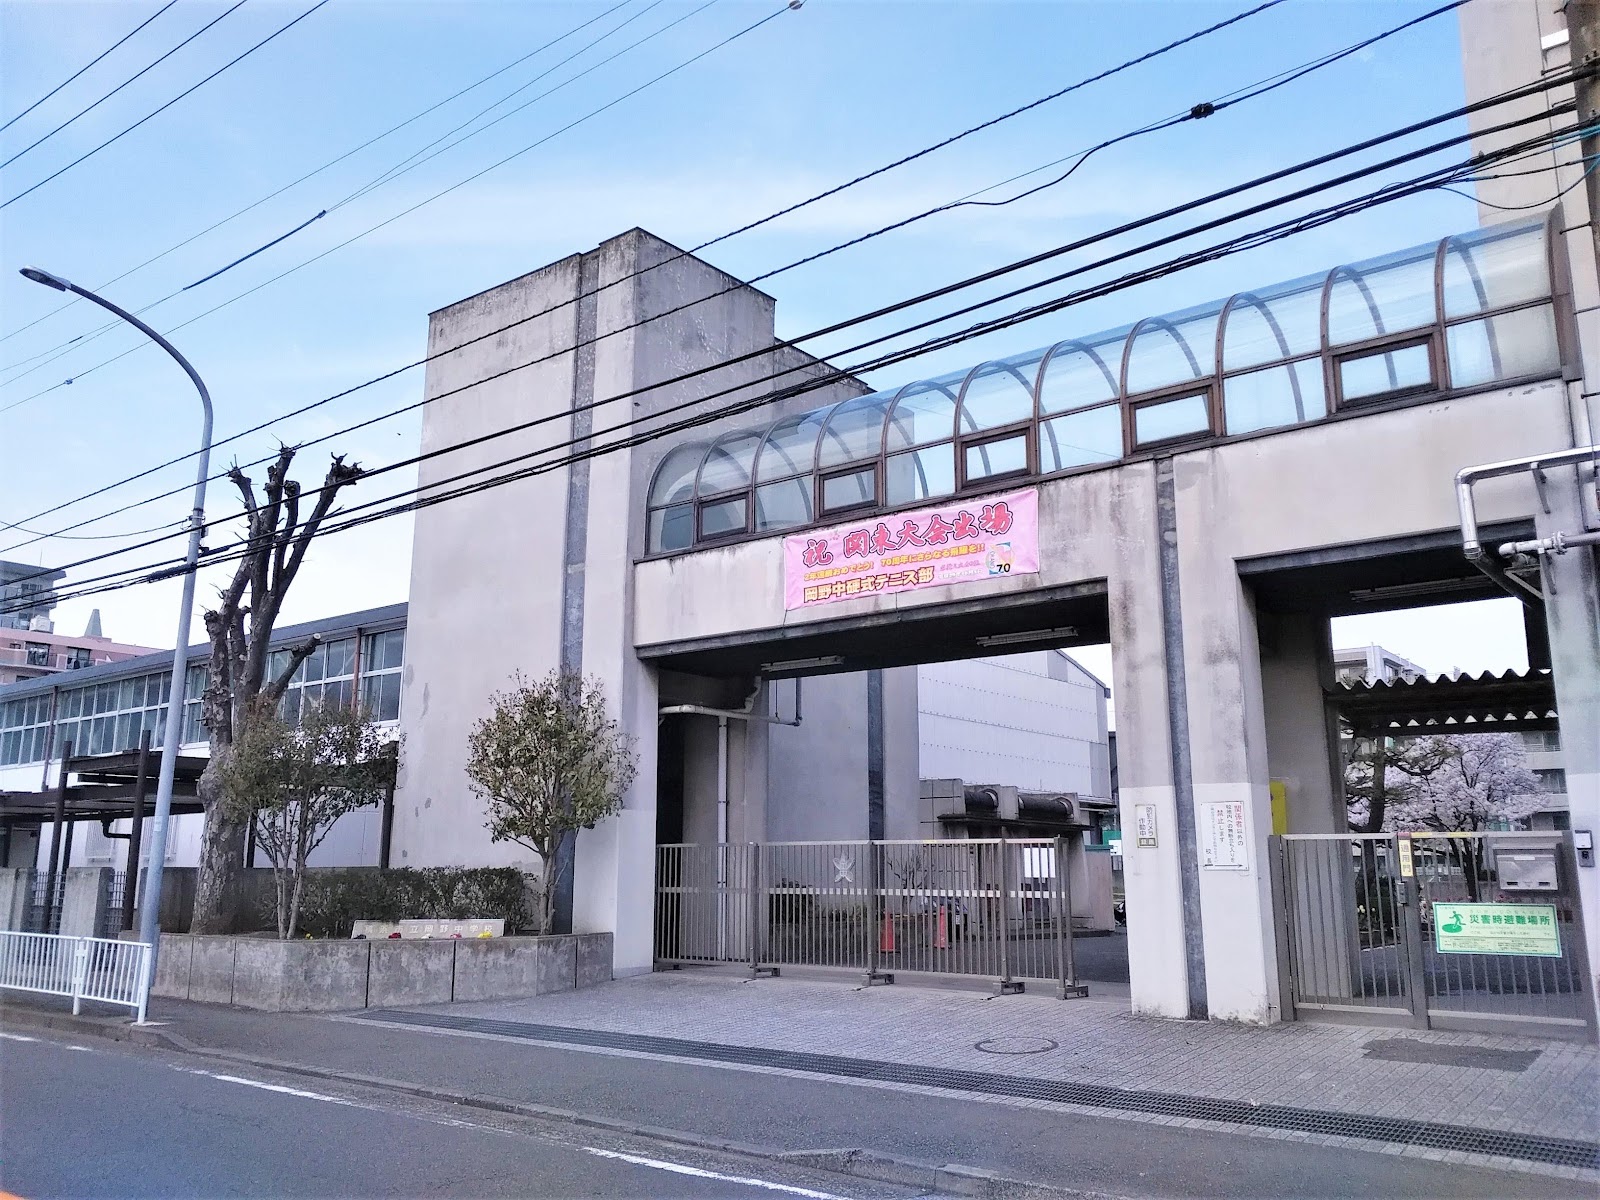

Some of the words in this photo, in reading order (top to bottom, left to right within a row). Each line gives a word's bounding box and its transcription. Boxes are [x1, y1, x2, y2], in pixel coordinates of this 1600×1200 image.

[803, 539, 834, 568] 祝
[843, 501, 1014, 559] 関東大会出場
[803, 566, 935, 603] 岡野中硬式テニス部
[996, 563, 1011, 573] 70
[1234, 804, 1244, 846] 関係者以外の
[1400, 843, 1412, 873] 通用門
[1469, 914, 1551, 926] 災害時避難場所
